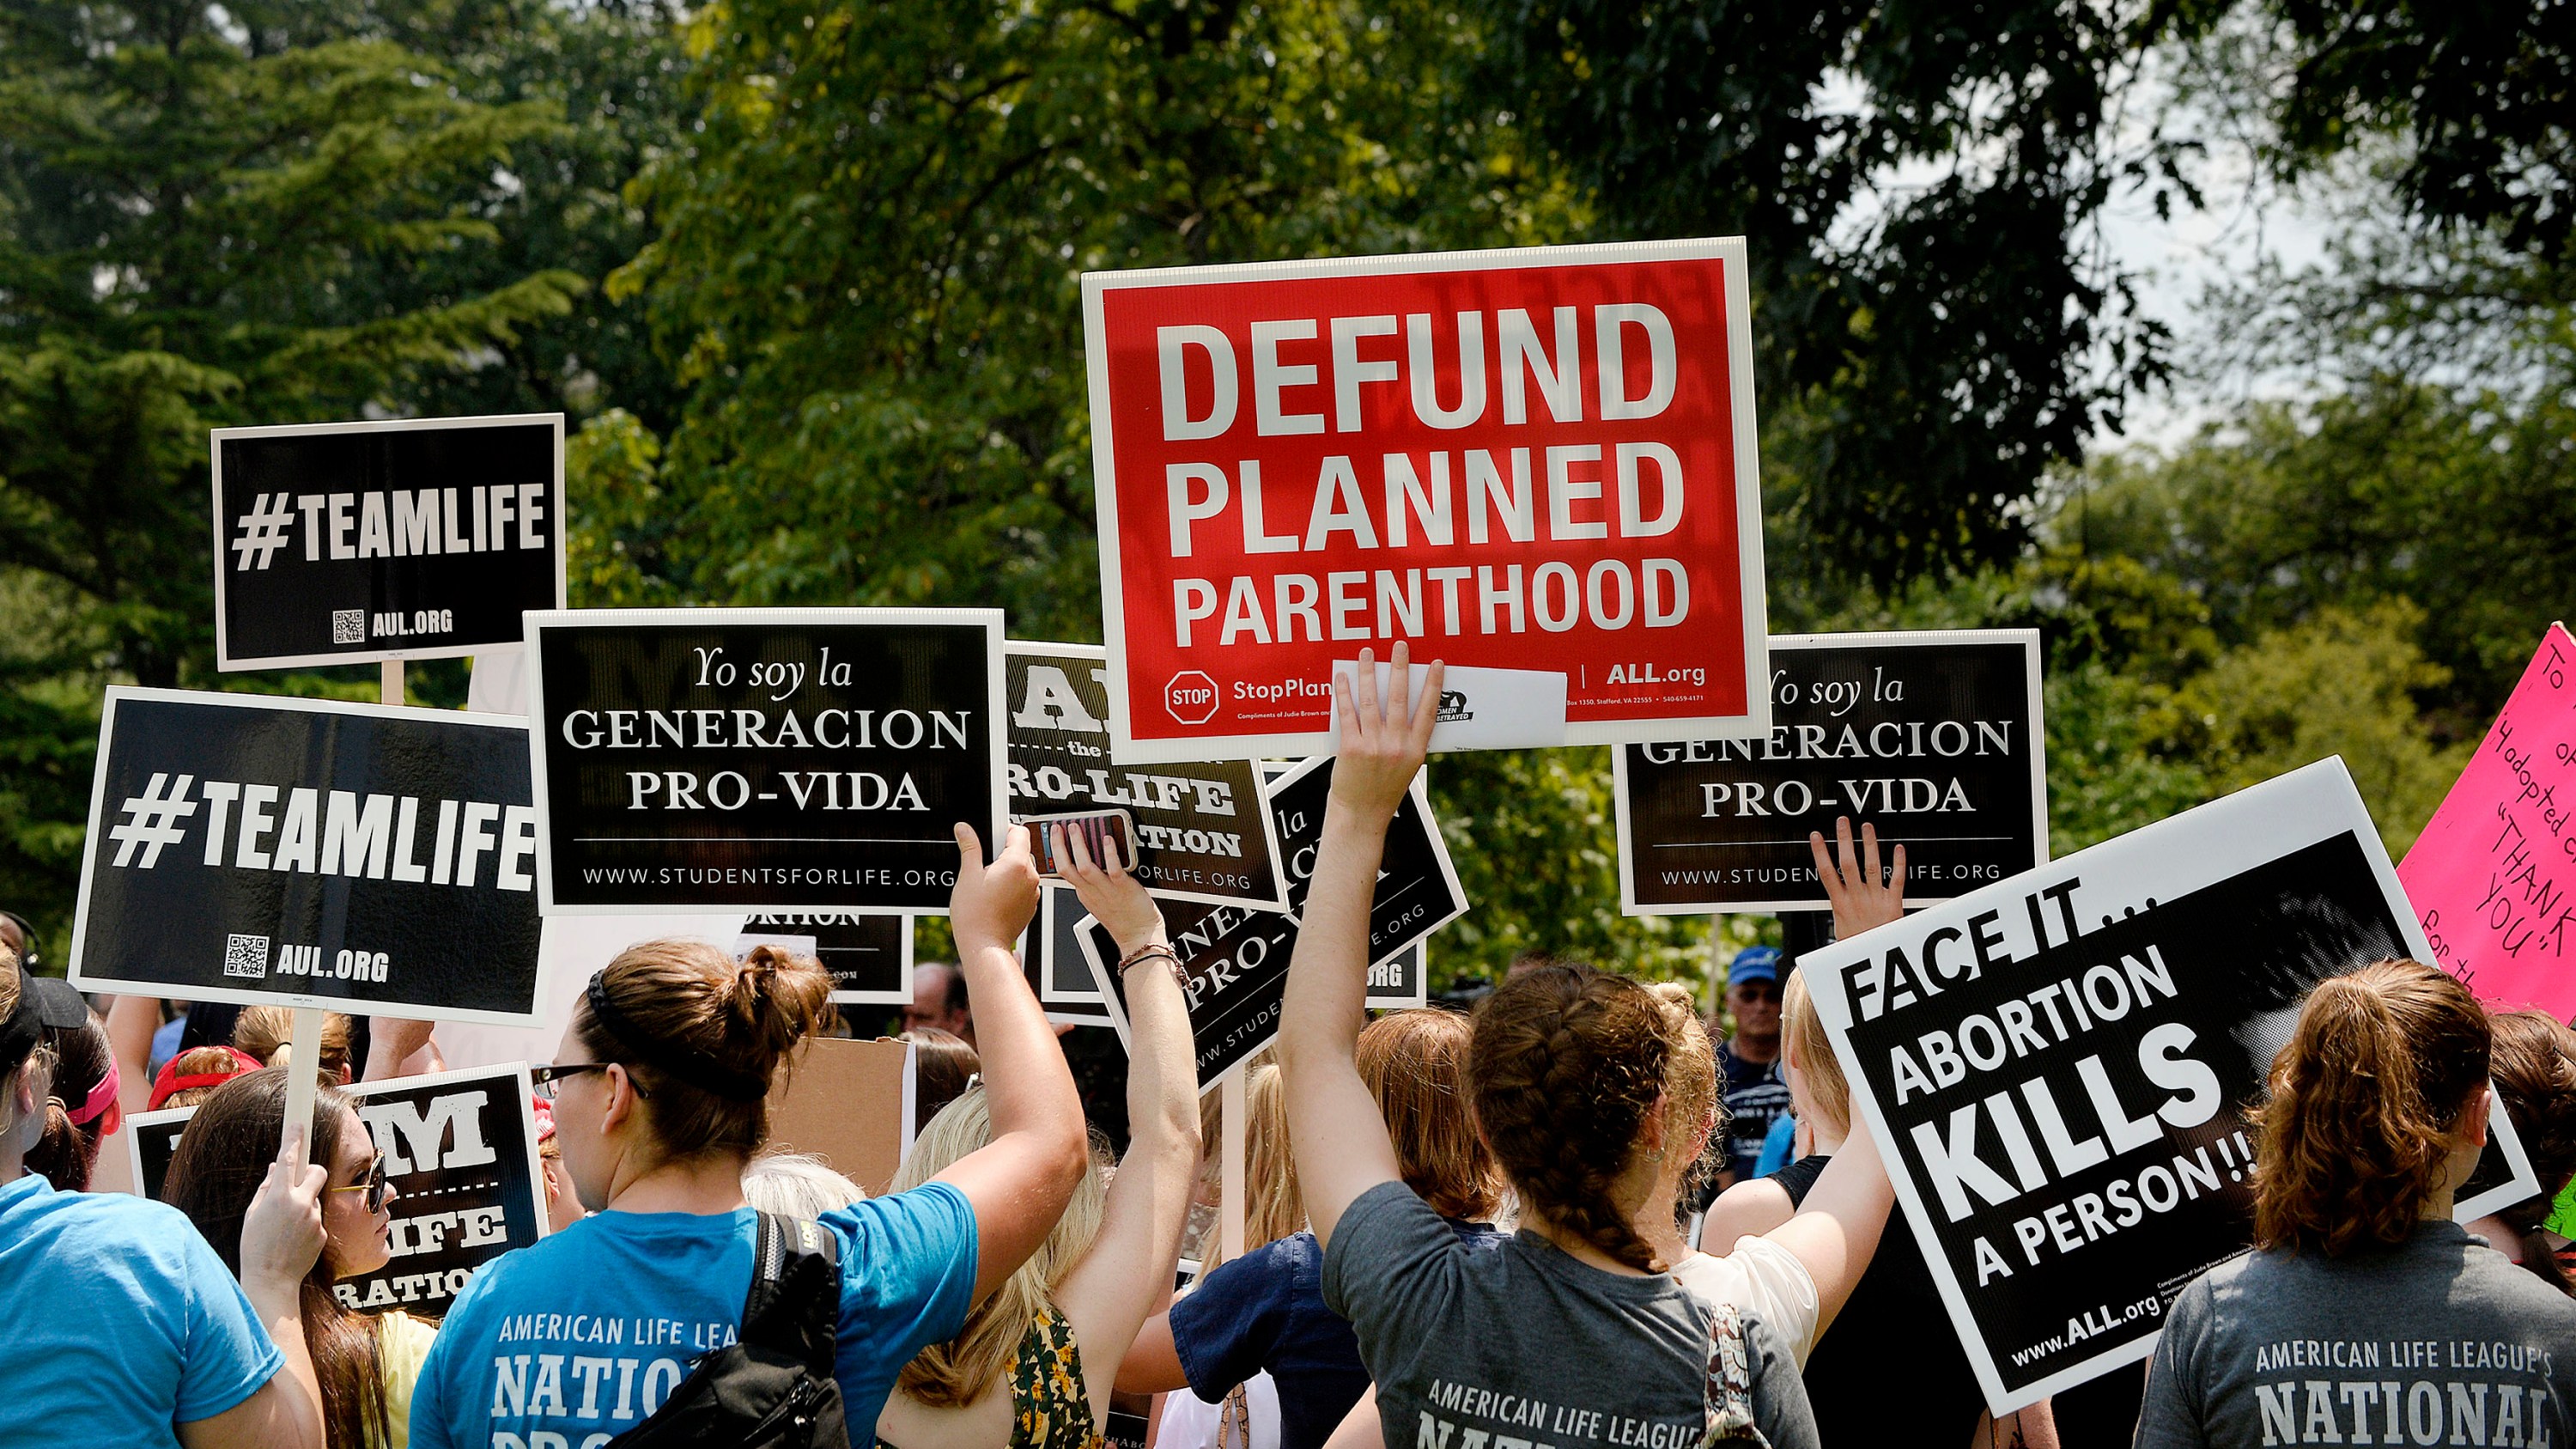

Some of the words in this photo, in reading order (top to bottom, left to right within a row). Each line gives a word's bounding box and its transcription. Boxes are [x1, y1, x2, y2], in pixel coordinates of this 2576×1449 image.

[1157, 302, 1677, 441] DEFUND
[1165, 441, 1685, 557] PLANNED
[232, 483, 545, 571] #TEAMLIFE
[372, 609, 453, 636] AUL.ORG
[1173, 557, 1690, 647] PARENTHOOD
[694, 647, 737, 686] Yo
[749, 660, 805, 701] soy
[819, 647, 852, 686] la
[1233, 678, 1332, 703] StopPlan
[1607, 663, 1705, 686] ALL.org
[1810, 681, 1861, 717] soy
[1874, 667, 1904, 702] la
[2543, 643, 2566, 689] To
[1012, 665, 1110, 734] A
[1172, 686, 1212, 705] STOP
[562, 709, 972, 750] GENERACION
[1067, 734, 1103, 757] the
[1641, 720, 2013, 764] GENERACION
[626, 771, 930, 811] PRO-VIDA
[1008, 764, 1236, 816] RO-LIFE
[1700, 777, 1977, 818] PRO-VIDA
[108, 772, 536, 892] #TEAMLIFE
[1278, 809, 1308, 839] la
[583, 868, 955, 886] WWW.STUDENTSFORLIFE.ORG
[1138, 865, 1250, 890] ORLIFE.ORG
[276, 943, 390, 983] AUL.ORG
[1839, 908, 2005, 1028] FACE
[1889, 945, 2178, 1105] ABORTION
[357, 1089, 497, 1178] M
[1909, 1022, 2222, 1224] KILLS
[388, 1205, 507, 1258] IFE
[1974, 1236, 2014, 1288] A
[498, 1313, 623, 1342] AMERICAN
[634, 1318, 683, 1346] LIFE
[694, 1323, 738, 1351] LEA
[2011, 1294, 2161, 1367] www.ALL.org
[2255, 1340, 2379, 1373] AMERICAN
[2390, 1341, 2439, 1368] LIFE
[2450, 1341, 2553, 1378] LEAGUE'S
[491, 1354, 684, 1421] NATIO
[1428, 1379, 1547, 1429] AMERICAN
[1553, 1405, 1601, 1440] LIFE
[2255, 1380, 2551, 1448] NATIONAL
